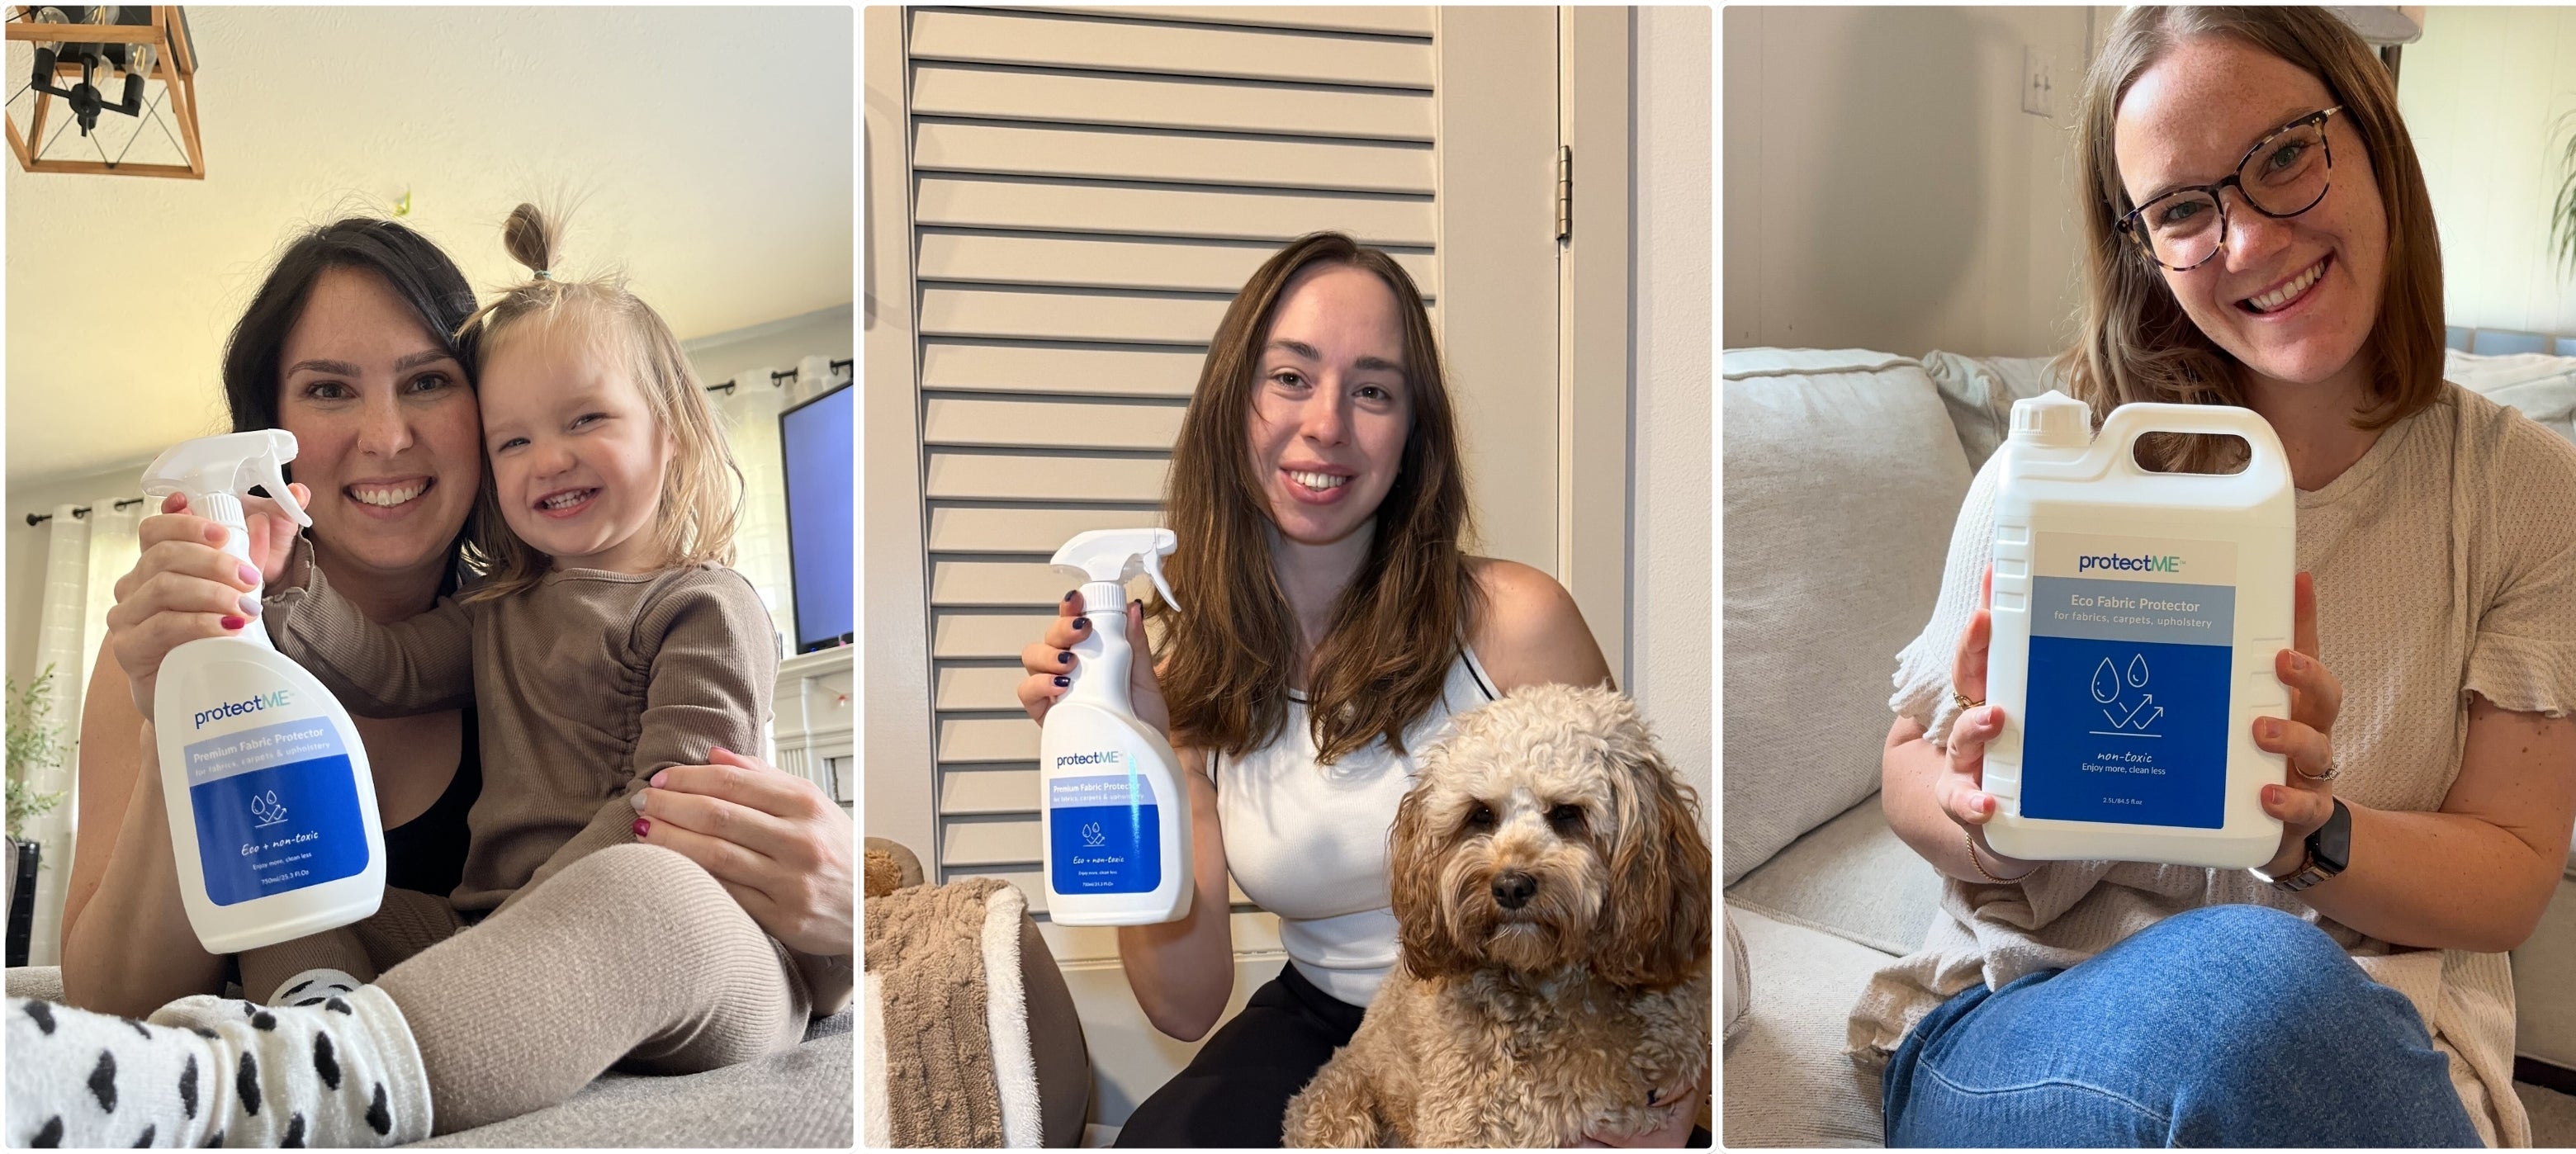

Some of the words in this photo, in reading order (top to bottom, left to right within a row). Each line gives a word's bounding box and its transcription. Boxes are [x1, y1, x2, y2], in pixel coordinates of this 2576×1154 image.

[2071, 594, 2094, 607] Eco
[2097, 595, 2136, 609] Fabric
[2139, 598, 2200, 612] Protector
[2053, 610, 2070, 620] for
[2072, 611, 2110, 623] fabrics,
[2113, 614, 2153, 627] carpets,
[2157, 617, 2213, 629] upholstery
[193, 745, 238, 764] Premium
[239, 736, 273, 752] Fabric
[274, 729, 324, 744] Protector
[277, 749, 284, 758] &
[286, 742, 331, 756] upholstery
[2097, 751, 2152, 763] non-toxic
[2081, 763, 2104, 773] Enjoy
[2105, 765, 2128, 773] more,
[2129, 766, 2149, 774] clean
[2151, 767, 2166, 775] less
[1053, 785, 1080, 793] Premium
[1080, 783, 1102, 792] Fabric
[2102, 797, 2130, 805] 2.5L/84.5
[241, 843, 259, 856] Eco
[272, 830, 319, 848] non-toxic
[1073, 855, 1084, 864] Eco
[1092, 855, 1124, 863] non-toxic
[252, 862, 268, 871] Enjoy
